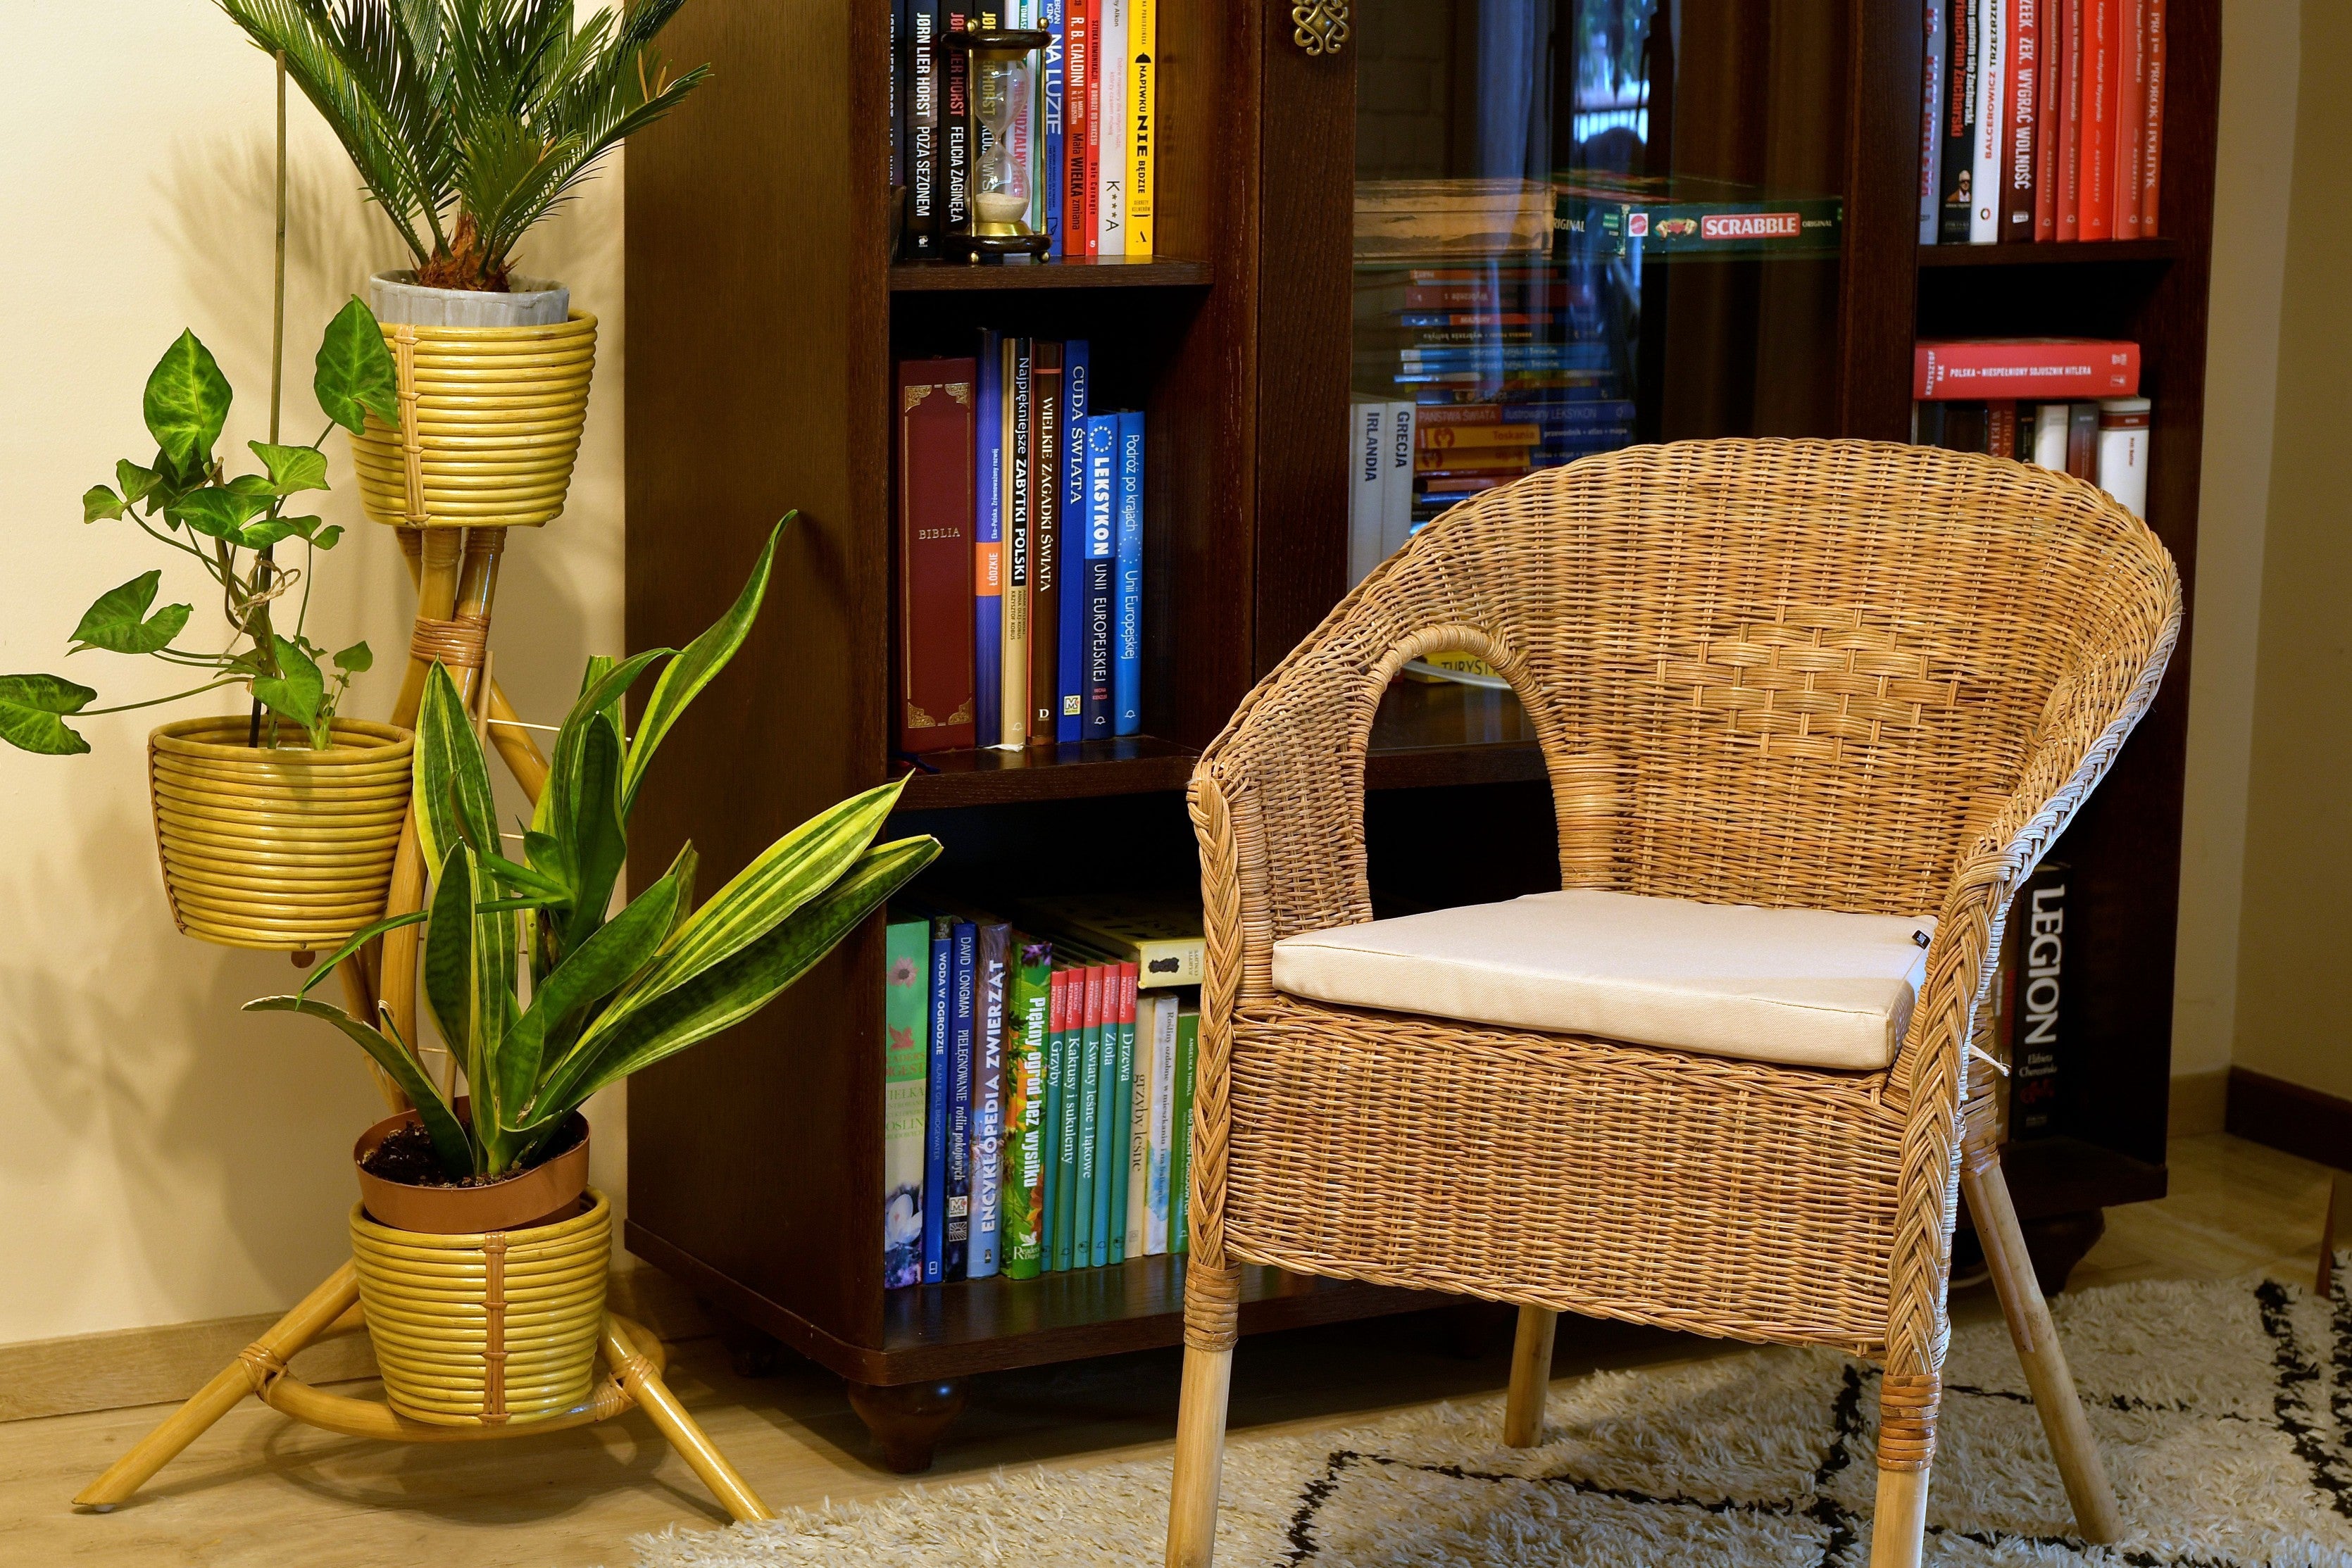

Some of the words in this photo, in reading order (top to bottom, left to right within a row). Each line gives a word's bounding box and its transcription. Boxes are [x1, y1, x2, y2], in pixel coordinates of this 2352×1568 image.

[916, 13, 930, 43] JØRN
[1070, 17, 1084, 29] R.
[1070, 30, 1084, 41] B.
[916, 47, 930, 73] LIER
[1046, 34, 1062, 61] NA
[1070, 44, 1084, 87] CIALDINI
[916, 77, 930, 117] HORST
[951, 76, 963, 115] HORST
[983, 76, 996, 115] HORST
[1046, 69, 1061, 135] LUZIE
[1138, 66, 1146, 113] NAPIWKU
[2015, 68, 2034, 124] WYGRAĆ
[2148, 62, 2160, 118] PROROK
[1137, 115, 1149, 158] NIE
[1984, 70, 1996, 159] BALCEROWICZ
[916, 127, 930, 158] POZA
[951, 127, 963, 166] FELICIA
[1072, 133, 1084, 154] Mała
[2014, 127, 2033, 190] WOLNOŚĆ
[2145, 131, 2158, 189] POLITYK
[916, 161, 930, 216] SEZONEM
[949, 169, 963, 222] ZAGINĘŁA
[1070, 157, 1084, 197] WIELKA
[1089, 182, 1097, 215] Carnegie
[1137, 161, 1146, 194] BĘDZIE
[1072, 199, 1083, 230] zmiana
[1706, 217, 1797, 236] SCRABBLE
[1072, 365, 1084, 421] CUDA
[1950, 368, 1975, 378] POLSKA
[2029, 366, 2063, 377] SOJUSZNIK
[2065, 365, 2091, 376] HITLERA
[1017, 356, 1030, 455] Najpiękniejsze
[1041, 397, 1053, 458] WIELKIE
[1418, 410, 1460, 422] PAŃSTWA
[1462, 407, 1496, 421] ŚWIATA
[1551, 407, 1597, 420] LEKSYKON
[1125, 434, 1139, 474] Podróż
[1365, 413, 1380, 482] IRLANDIA
[1395, 411, 1410, 469] GRECJA
[1070, 427, 1086, 504] ŚWIATA
[1125, 477, 1137, 491] po
[1015, 458, 1027, 522] ZABYTKI
[1041, 463, 1052, 531] ZAGADKI
[1093, 457, 1110, 556] LEKSYKON
[918, 527, 961, 541] BIBLIA
[1124, 494, 1138, 532] krajach
[989, 552, 999, 587] ŁÓDZKIE
[1014, 527, 1025, 581] POLSKI
[1039, 532, 1053, 593] ŚWIATA
[1094, 563, 1108, 591] UNII
[1125, 570, 1138, 593] Unii
[1093, 597, 1107, 682] EUROPEJSKIEJ
[1121, 596, 1139, 659] Europejskiej
[937, 952, 946, 986] WODA
[961, 936, 972, 966] DAVID
[2025, 884, 2065, 1045] LEGION
[937, 988, 945, 998] W
[958, 970, 970, 1018] LONGMAN
[984, 960, 1006, 1069] ZWIERZĄT
[935, 1001, 945, 1055] OGRODZIE
[1027, 997, 1046, 1047] Piękny
[1165, 1012, 1175, 1043] Rośliny
[955, 1029, 969, 1101] PIELĘGNOWANIE
[1048, 1041, 1063, 1087] Grzyby
[1063, 1037, 1080, 1090] Kaktusy
[1084, 1041, 1099, 1086] Kwiaty
[1103, 1032, 1116, 1066] Zioła
[1121, 1032, 1134, 1081] Drzewa
[1026, 1052, 1042, 1095] ogród
[955, 1107, 968, 1131] roślin
[1025, 1100, 1041, 1125] bez
[1084, 1090, 1097, 1122] leśne
[1132, 1074, 1146, 1127] grzyby
[1161, 1094, 1170, 1145] mieszkaniu
[951, 1132, 965, 1180] pokojowych
[982, 1074, 1000, 1231] ENCYKLOPEDIA
[1061, 1103, 1079, 1165] sukulenty
[1080, 1134, 1095, 1179] łąkowe
[1132, 1131, 1148, 1172] leśne
[1024, 1131, 1041, 1187] wysiłku
[1161, 1153, 1166, 1163] na
